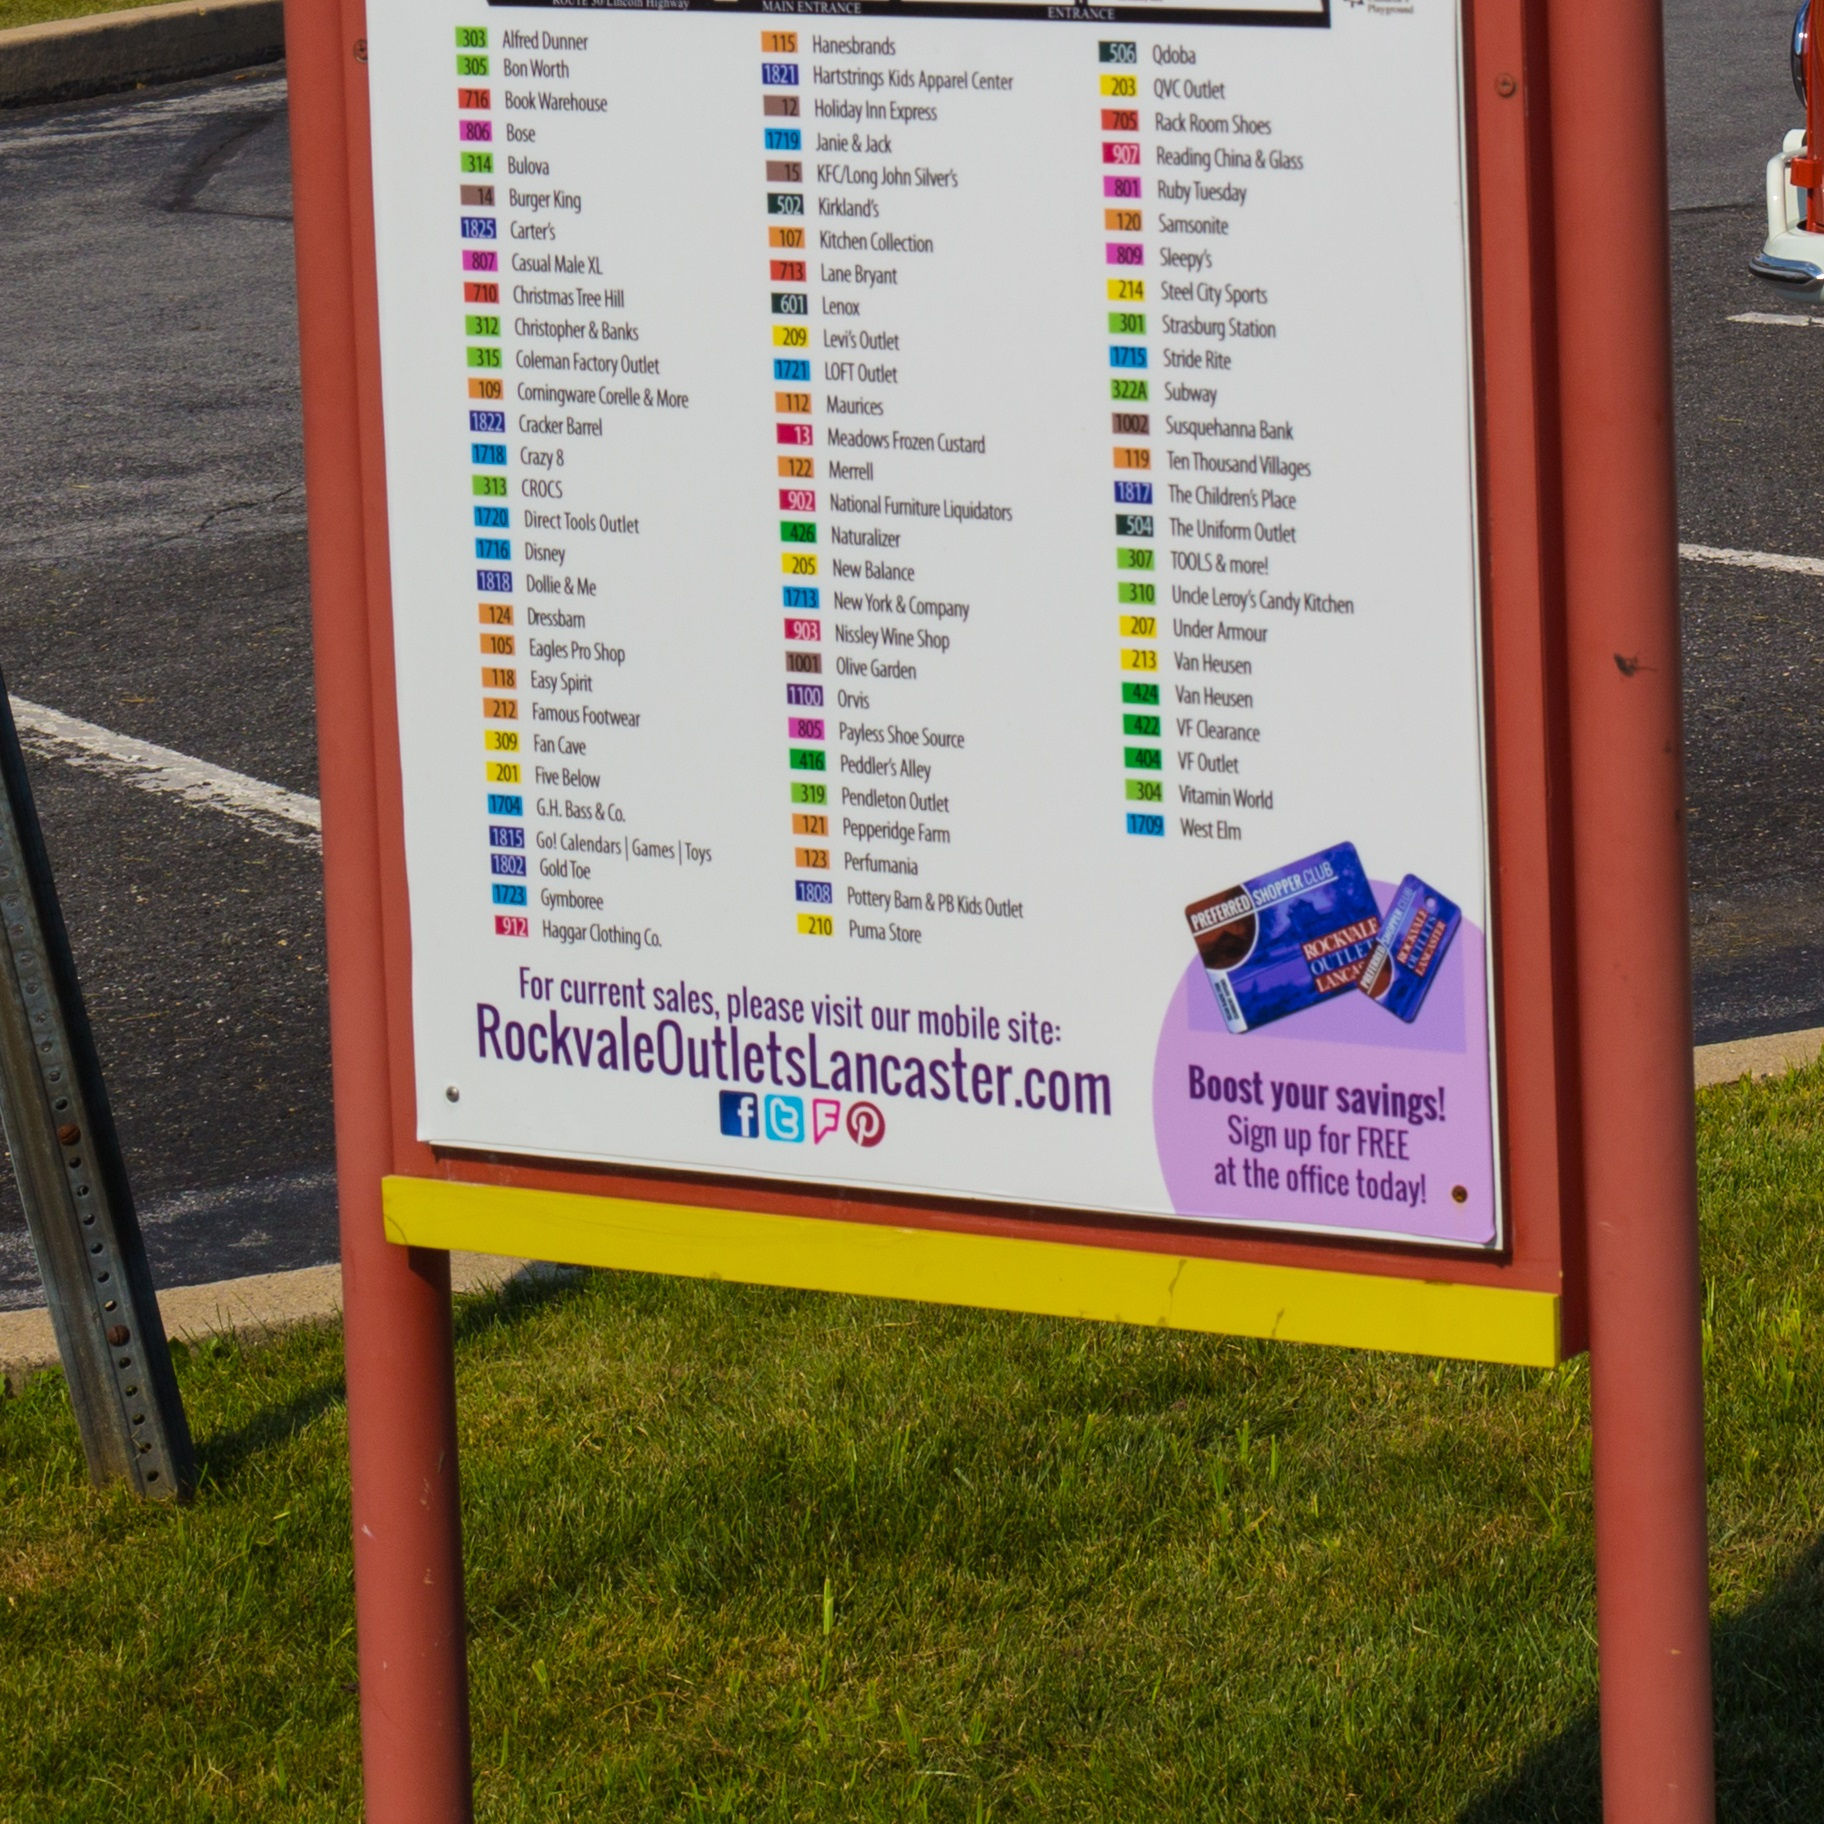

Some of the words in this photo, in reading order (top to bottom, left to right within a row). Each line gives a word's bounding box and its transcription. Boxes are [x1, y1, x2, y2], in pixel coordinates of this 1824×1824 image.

[762, 0, 796, 14] MAIN
[797, 1, 862, 15] ENTRANCE
[1047, 7, 1115, 21] ENTRANCE
[461, 30, 487, 47] 303
[502, 29, 539, 49] Alfred
[542, 30, 588, 50] Dunner
[812, 34, 896, 55] Hanesbrands
[463, 58, 487, 76] 305
[503, 58, 528, 77] Bon
[530, 58, 569, 78] Worth
[464, 91, 489, 108] 716
[505, 90, 536, 110] Book
[538, 91, 607, 112] Warehouse
[465, 124, 491, 141] 806
[506, 123, 535, 143] Bose
[467, 156, 493, 173] 314
[507, 155, 549, 175] Bulova
[819, 230, 867, 250] Kitchen
[870, 231, 933, 253] Collection
[471, 253, 496, 270] 807
[511, 252, 551, 272] Casual
[554, 254, 585, 274] Male
[588, 256, 603, 275] XL
[513, 284, 574, 306] Christmas
[576, 287, 601, 307] Tree
[604, 289, 624, 307] Hill
[1162, 314, 1225, 341] Strasburg
[1228, 317, 1276, 338] Station
[515, 349, 570, 370] Coleman
[573, 352, 618, 377] Factory
[620, 354, 659, 374] Outlet
[831, 526, 900, 548] Naturalizer
[529, 638, 568, 662] Eagles
[571, 640, 591, 660] Pro
[593, 642, 625, 667] Shop
[532, 701, 579, 723] Famous
[582, 705, 640, 727] Footwear
[844, 851, 918, 875] Perfumania
[1190, 894, 1251, 931] PREFERRED
[1253, 874, 1303, 906] SHOPPER
[1302, 861, 1334, 886] CLUB
[1304, 916, 1380, 960] ROCKVALE
[1398, 909, 1428, 964] ROCKVALE
[1416, 921, 1447, 976] LANCASTER
[518, 966, 554, 1001] For
[560, 978, 646, 1010] current
[652, 980, 720, 1020] sales,
[727, 986, 805, 1024] please
[811, 994, 863, 1029] visit
[871, 1005, 911, 1033] our
[918, 1004, 1000, 1040] mobile
[1008, 1011, 1062, 1045] site:
[477, 1002, 1112, 1116] RockvaleOutletsLancaster.com
[1189, 1064, 1264, 1106] Boost
[1270, 1080, 1329, 1112] your
[1335, 1083, 1446, 1126] savings!
[1227, 1114, 1277, 1153] Sign
[1284, 1127, 1312, 1157] up
[1318, 1124, 1351, 1154] for
[1357, 1126, 1410, 1161] FREE
[1214, 1157, 1237, 1186] at
[1243, 1158, 1279, 1190] the
[1286, 1164, 1349, 1196] office
[1356, 1169, 1427, 1208] today!
